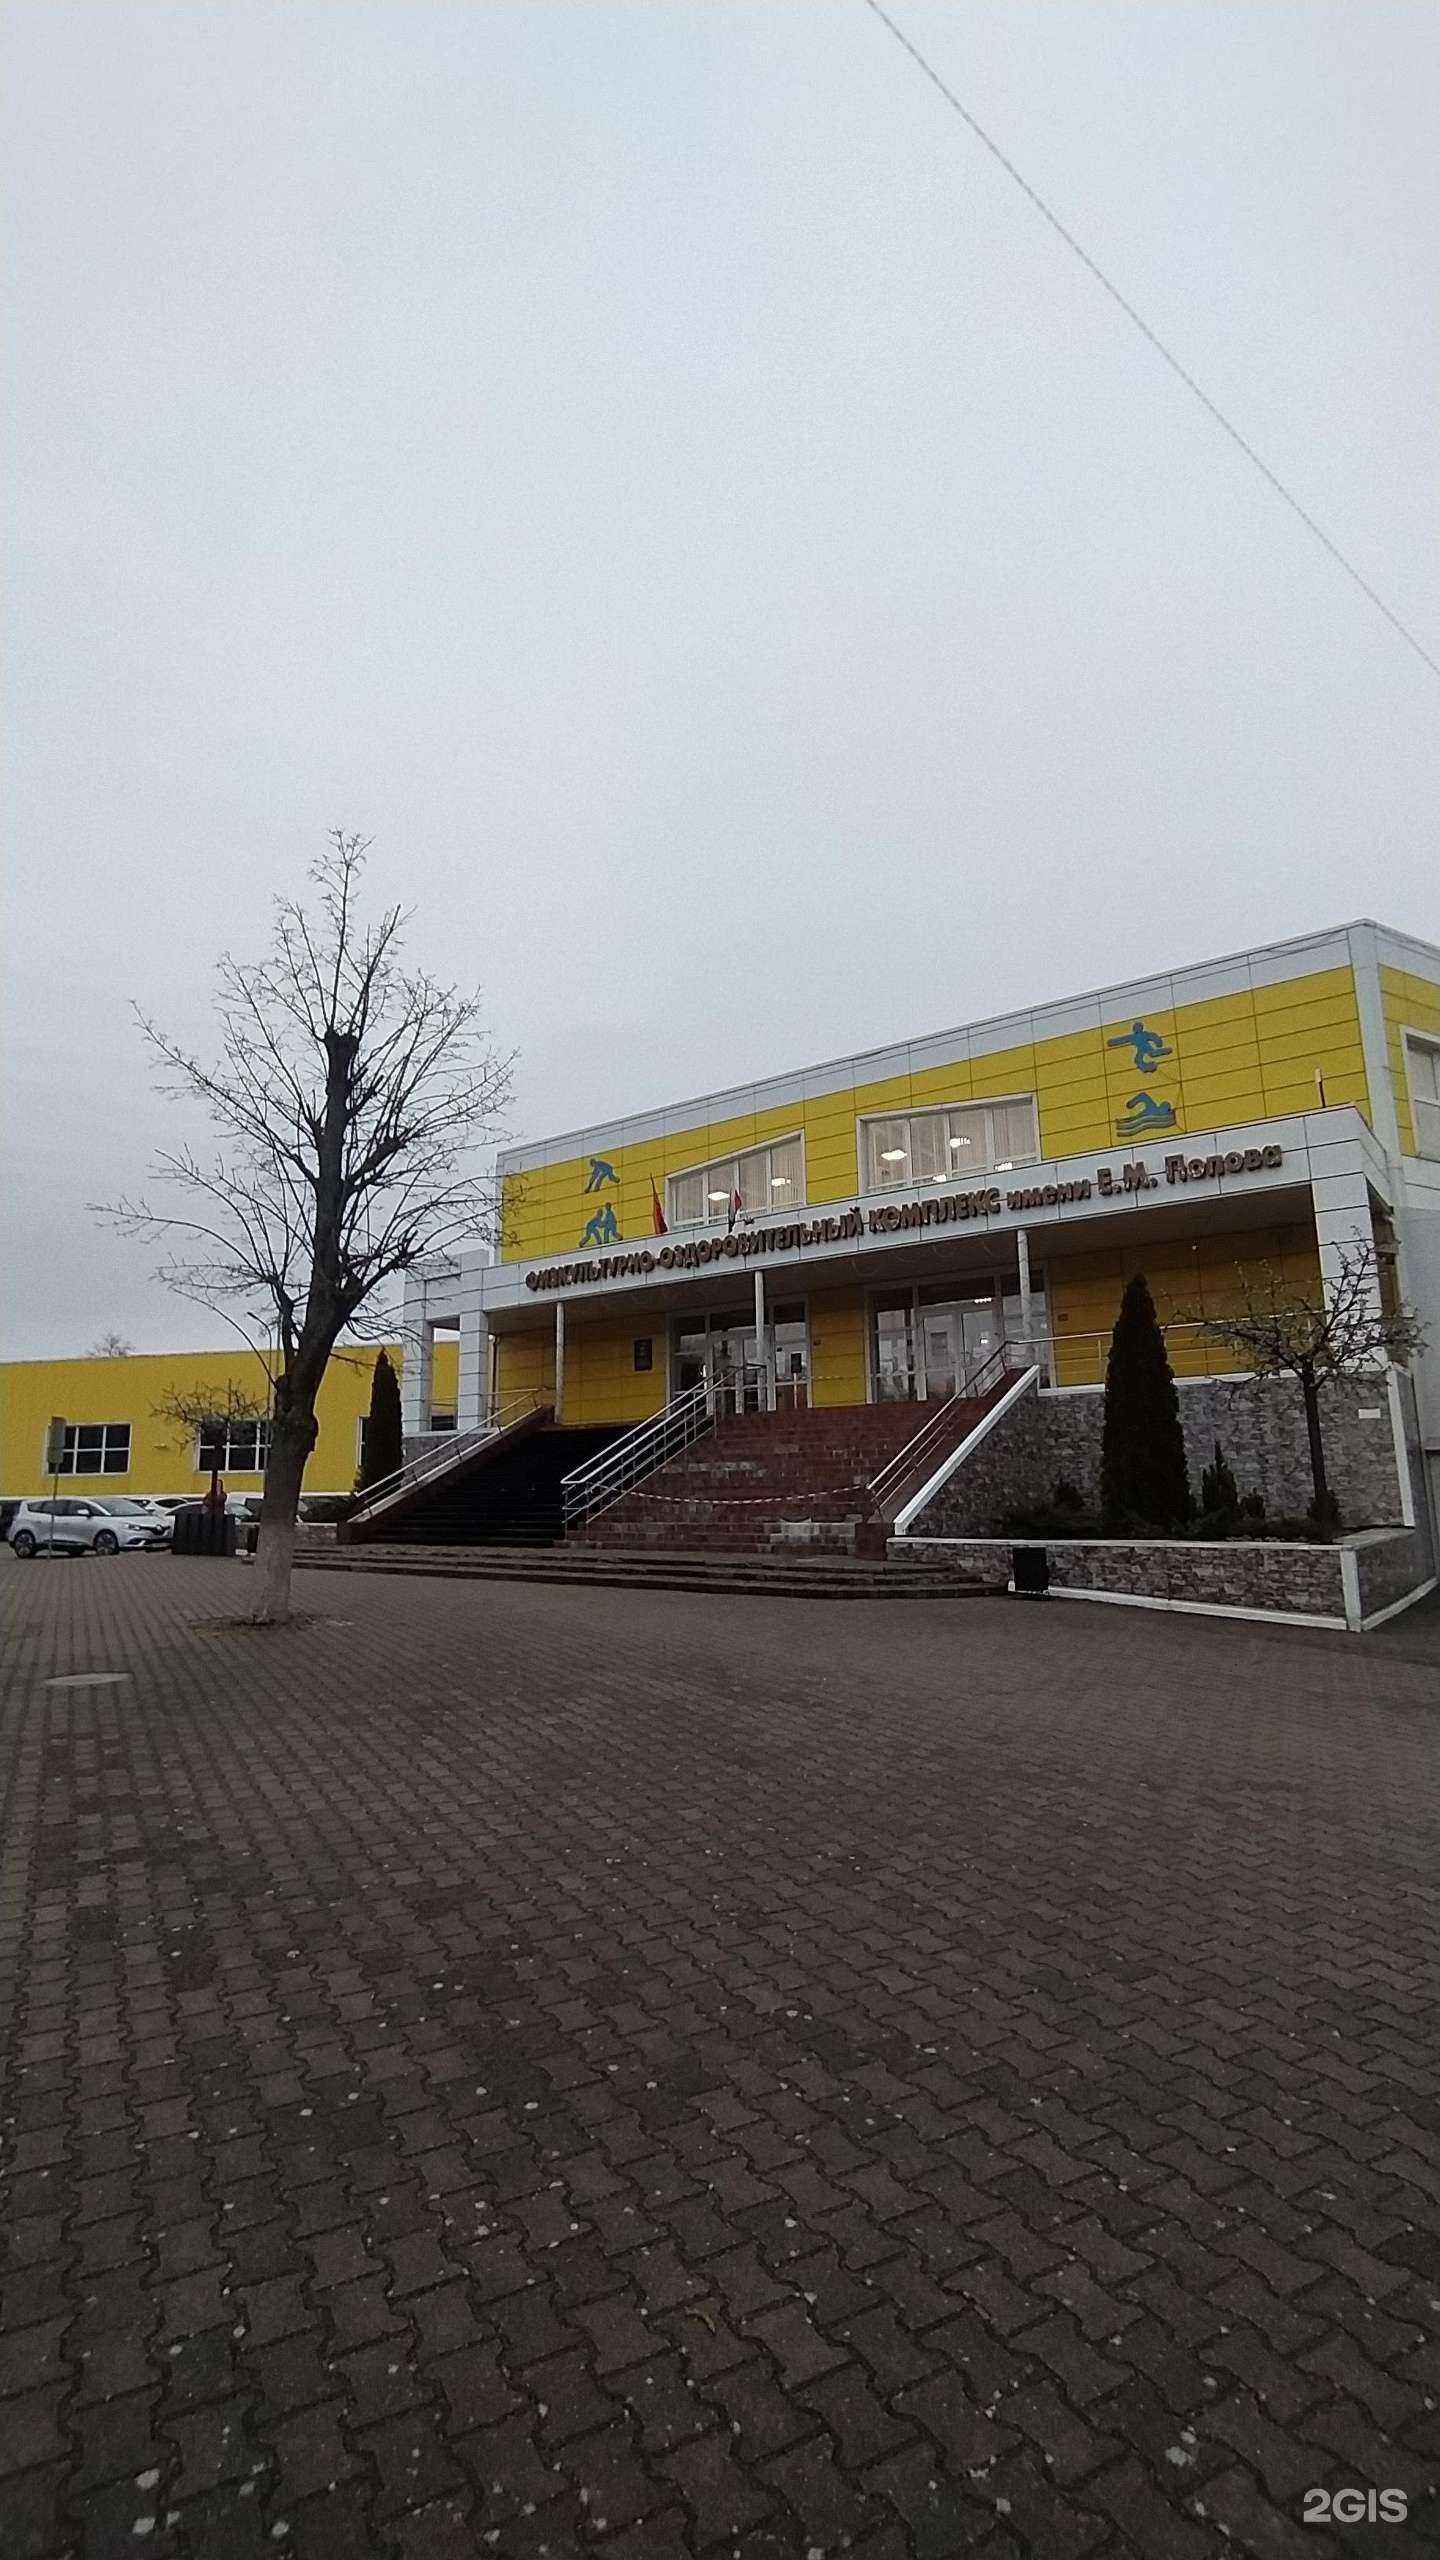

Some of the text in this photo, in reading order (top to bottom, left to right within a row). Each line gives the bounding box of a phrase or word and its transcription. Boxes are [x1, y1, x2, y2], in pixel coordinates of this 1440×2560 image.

[868, 1187, 1001, 1234] КОМПЛЕКС
[1006, 1179, 1091, 1210] имени
[1097, 1161, 1158, 1196] Е.М.
[1164, 1144, 1282, 1184] Попова
